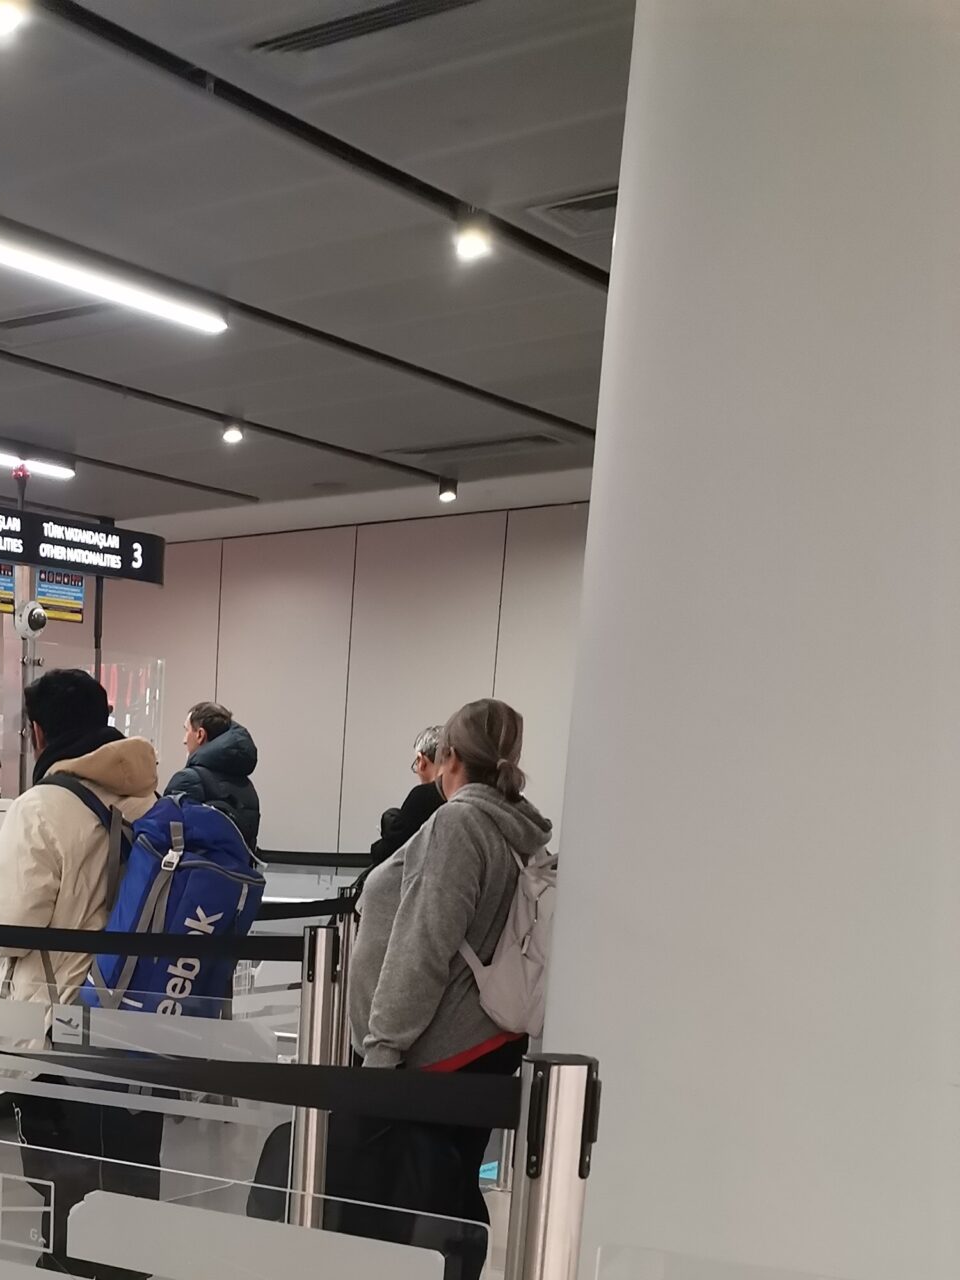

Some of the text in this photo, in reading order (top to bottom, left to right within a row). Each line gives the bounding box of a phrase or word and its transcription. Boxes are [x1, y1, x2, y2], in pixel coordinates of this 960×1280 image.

[42, 521, 64, 540] TÜRK
[39, 543, 122, 569] OTHER NATIONALITIES
[131, 542, 143, 569] 3
[156, 905, 224, 1017] eebk
